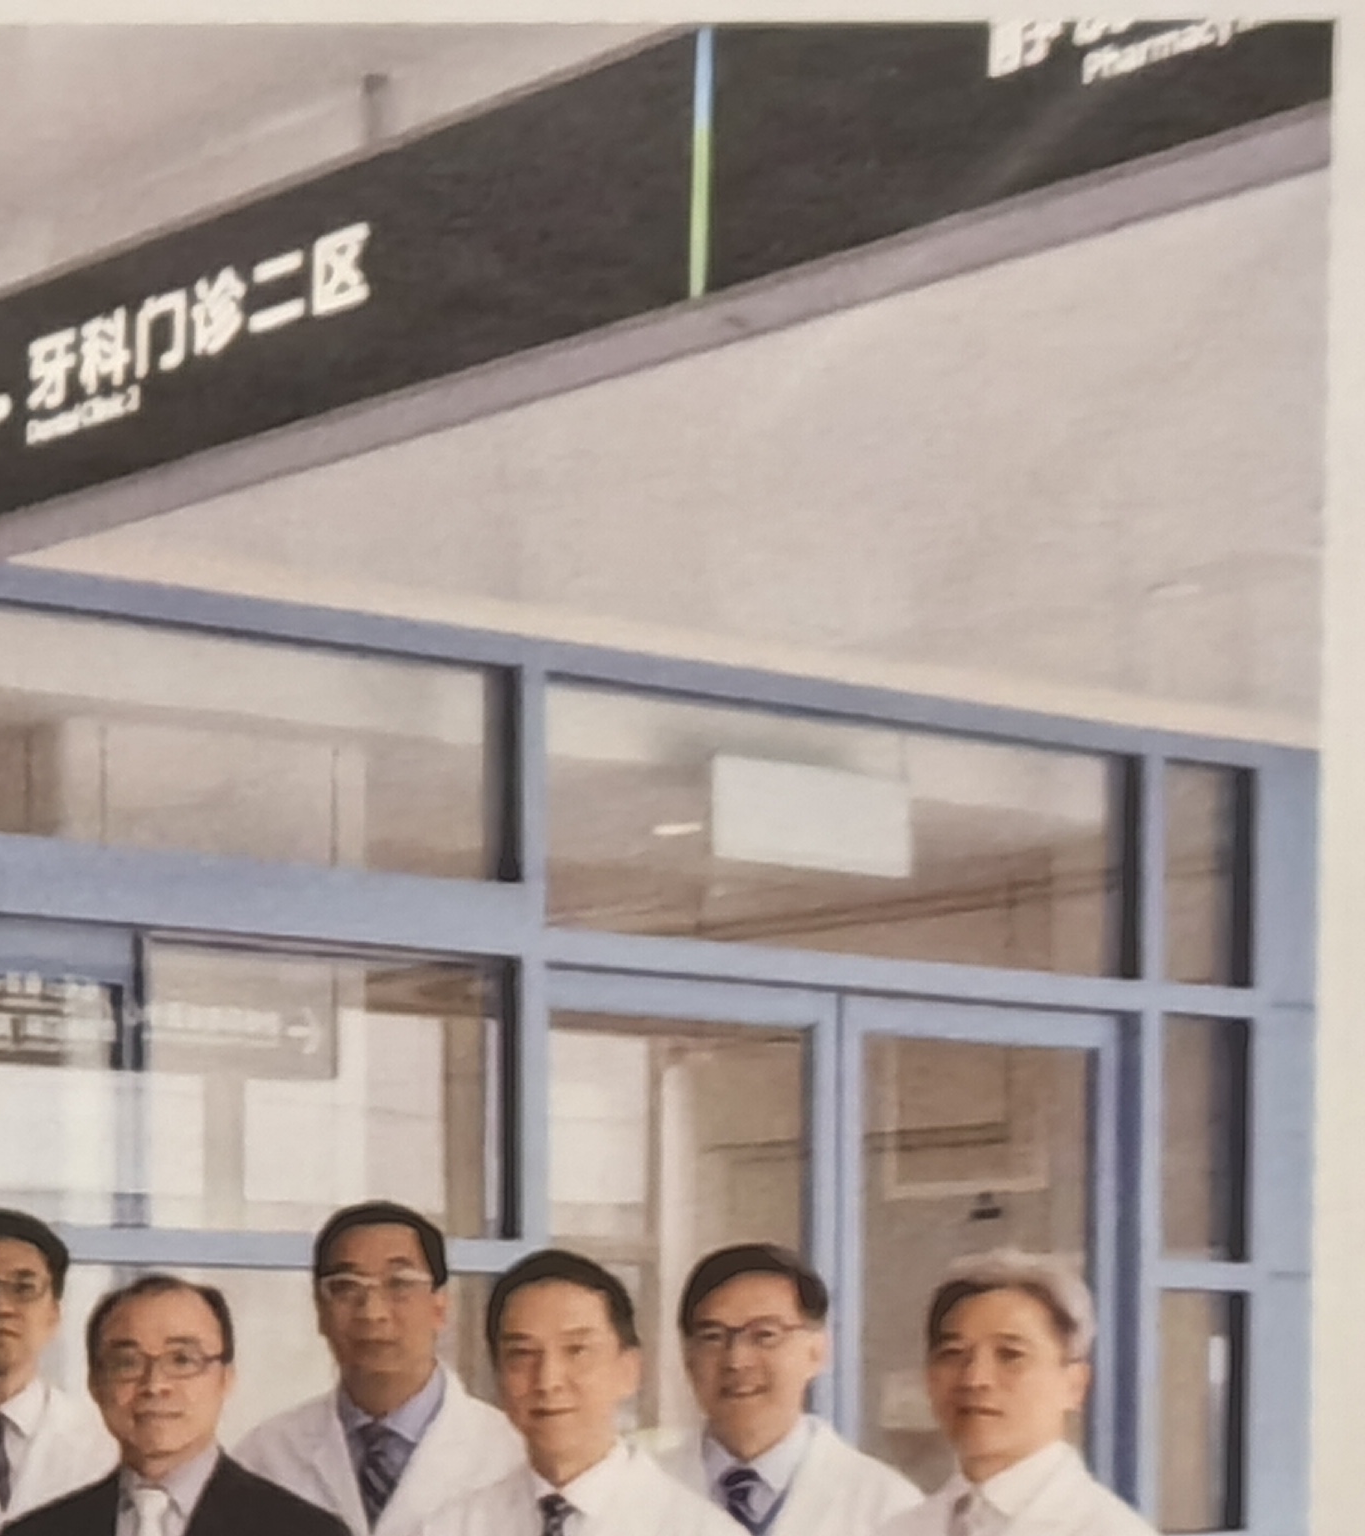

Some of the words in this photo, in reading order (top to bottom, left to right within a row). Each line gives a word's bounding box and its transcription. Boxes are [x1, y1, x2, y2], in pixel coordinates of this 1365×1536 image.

[26, 222, 370, 411] 牙科门诊二区
